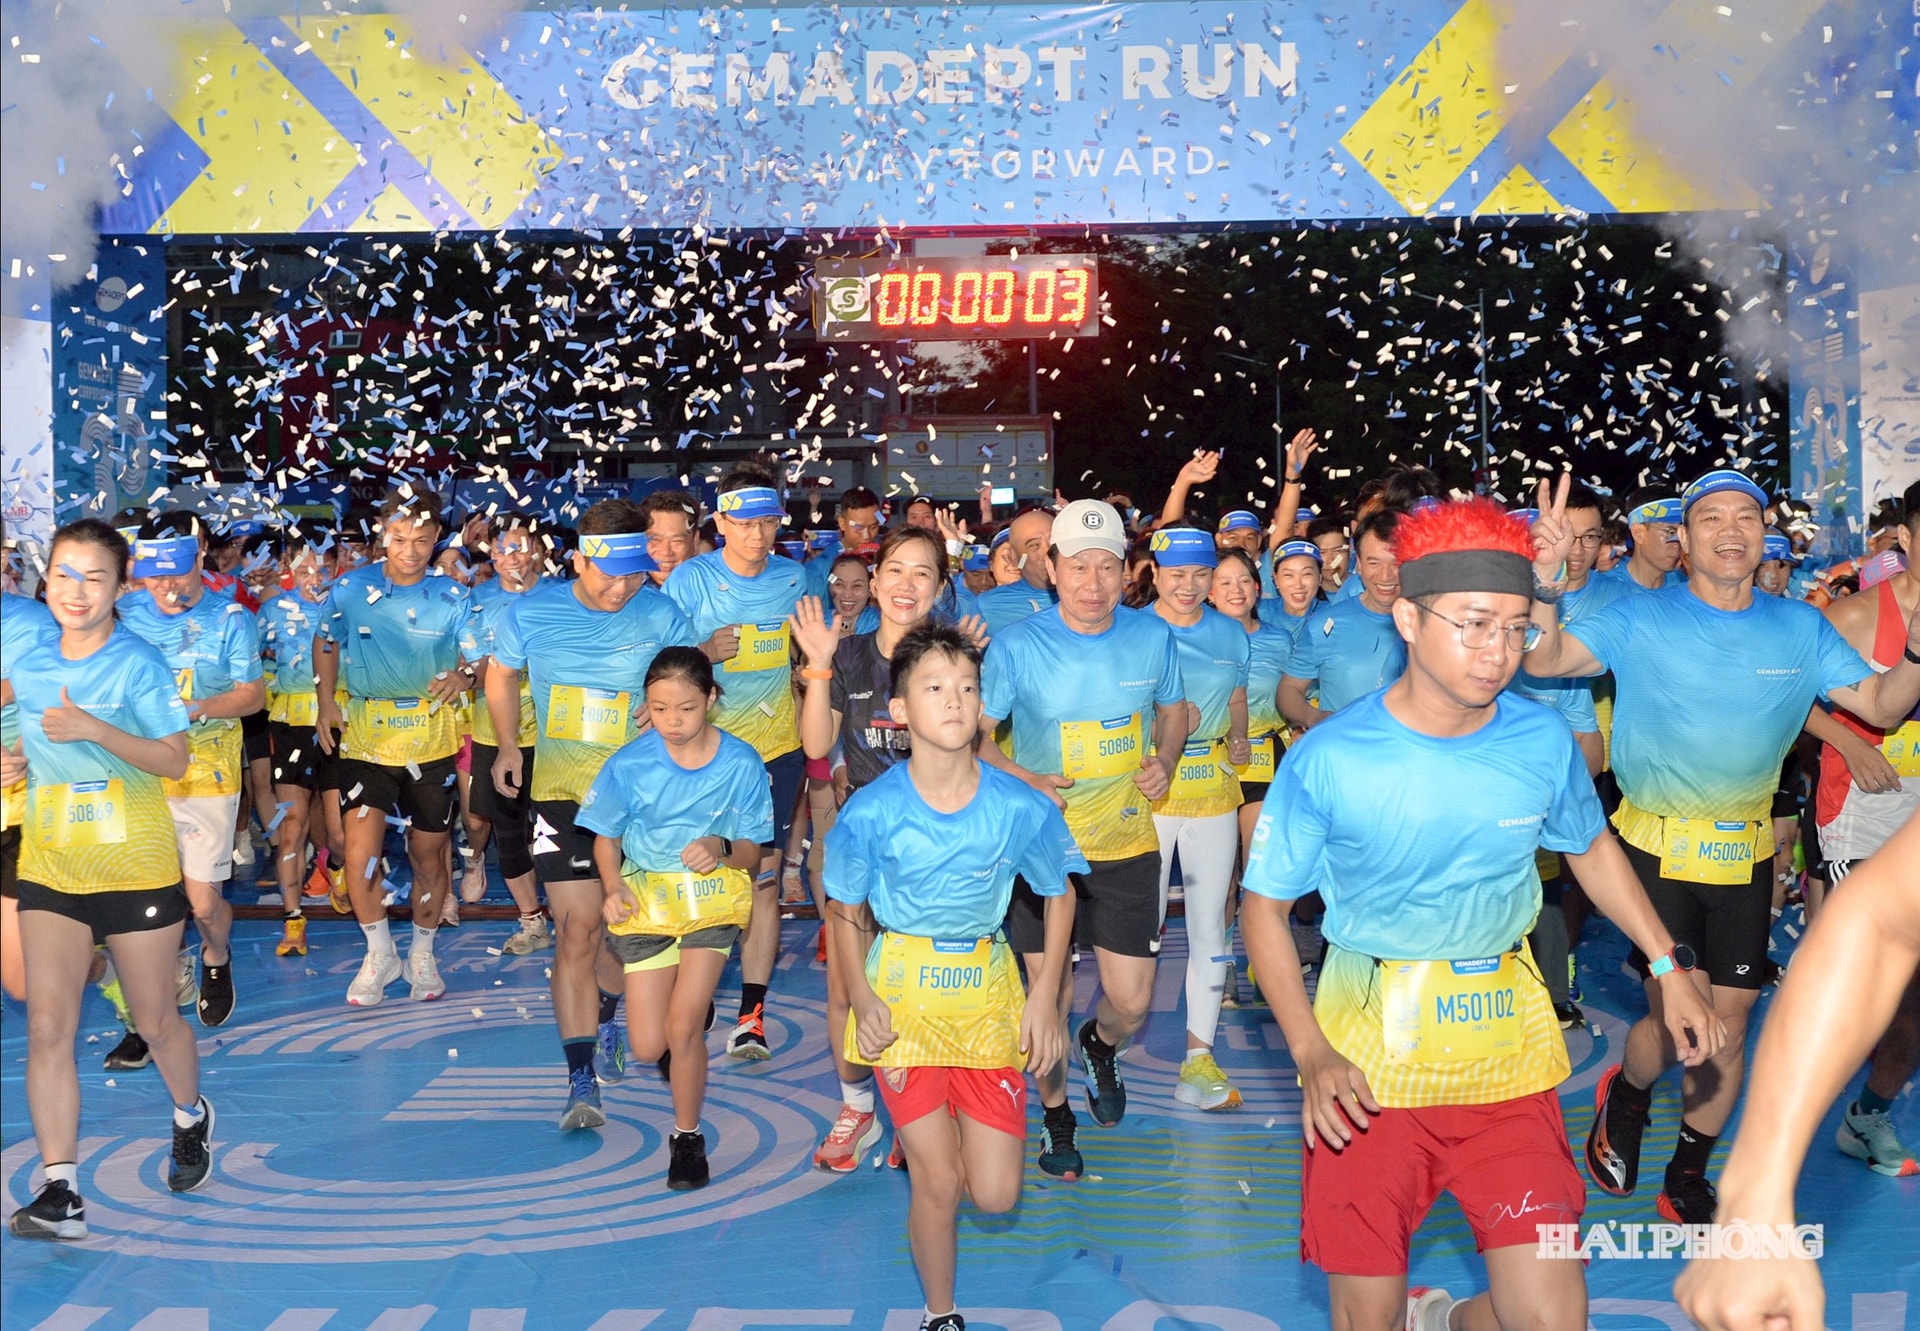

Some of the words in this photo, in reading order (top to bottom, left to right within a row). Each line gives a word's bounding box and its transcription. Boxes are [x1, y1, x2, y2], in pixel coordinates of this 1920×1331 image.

[606, 46, 1088, 109] GEMADEPT
[1121, 41, 1297, 101] RUN
[823, 150, 940, 182] WAY
[960, 146, 1215, 179] FORWARD
[753, 637, 784, 654] 50880
[387, 714, 427, 729] M50492
[581, 705, 619, 725] 50873
[1099, 733, 1135, 756] 50886
[1180, 763, 1215, 781] 50883
[68, 801, 113, 824] 50869
[1698, 840, 1752, 861] M50024
[919, 965, 983, 989] F50090
[1436, 988, 1515, 1025] M50102
